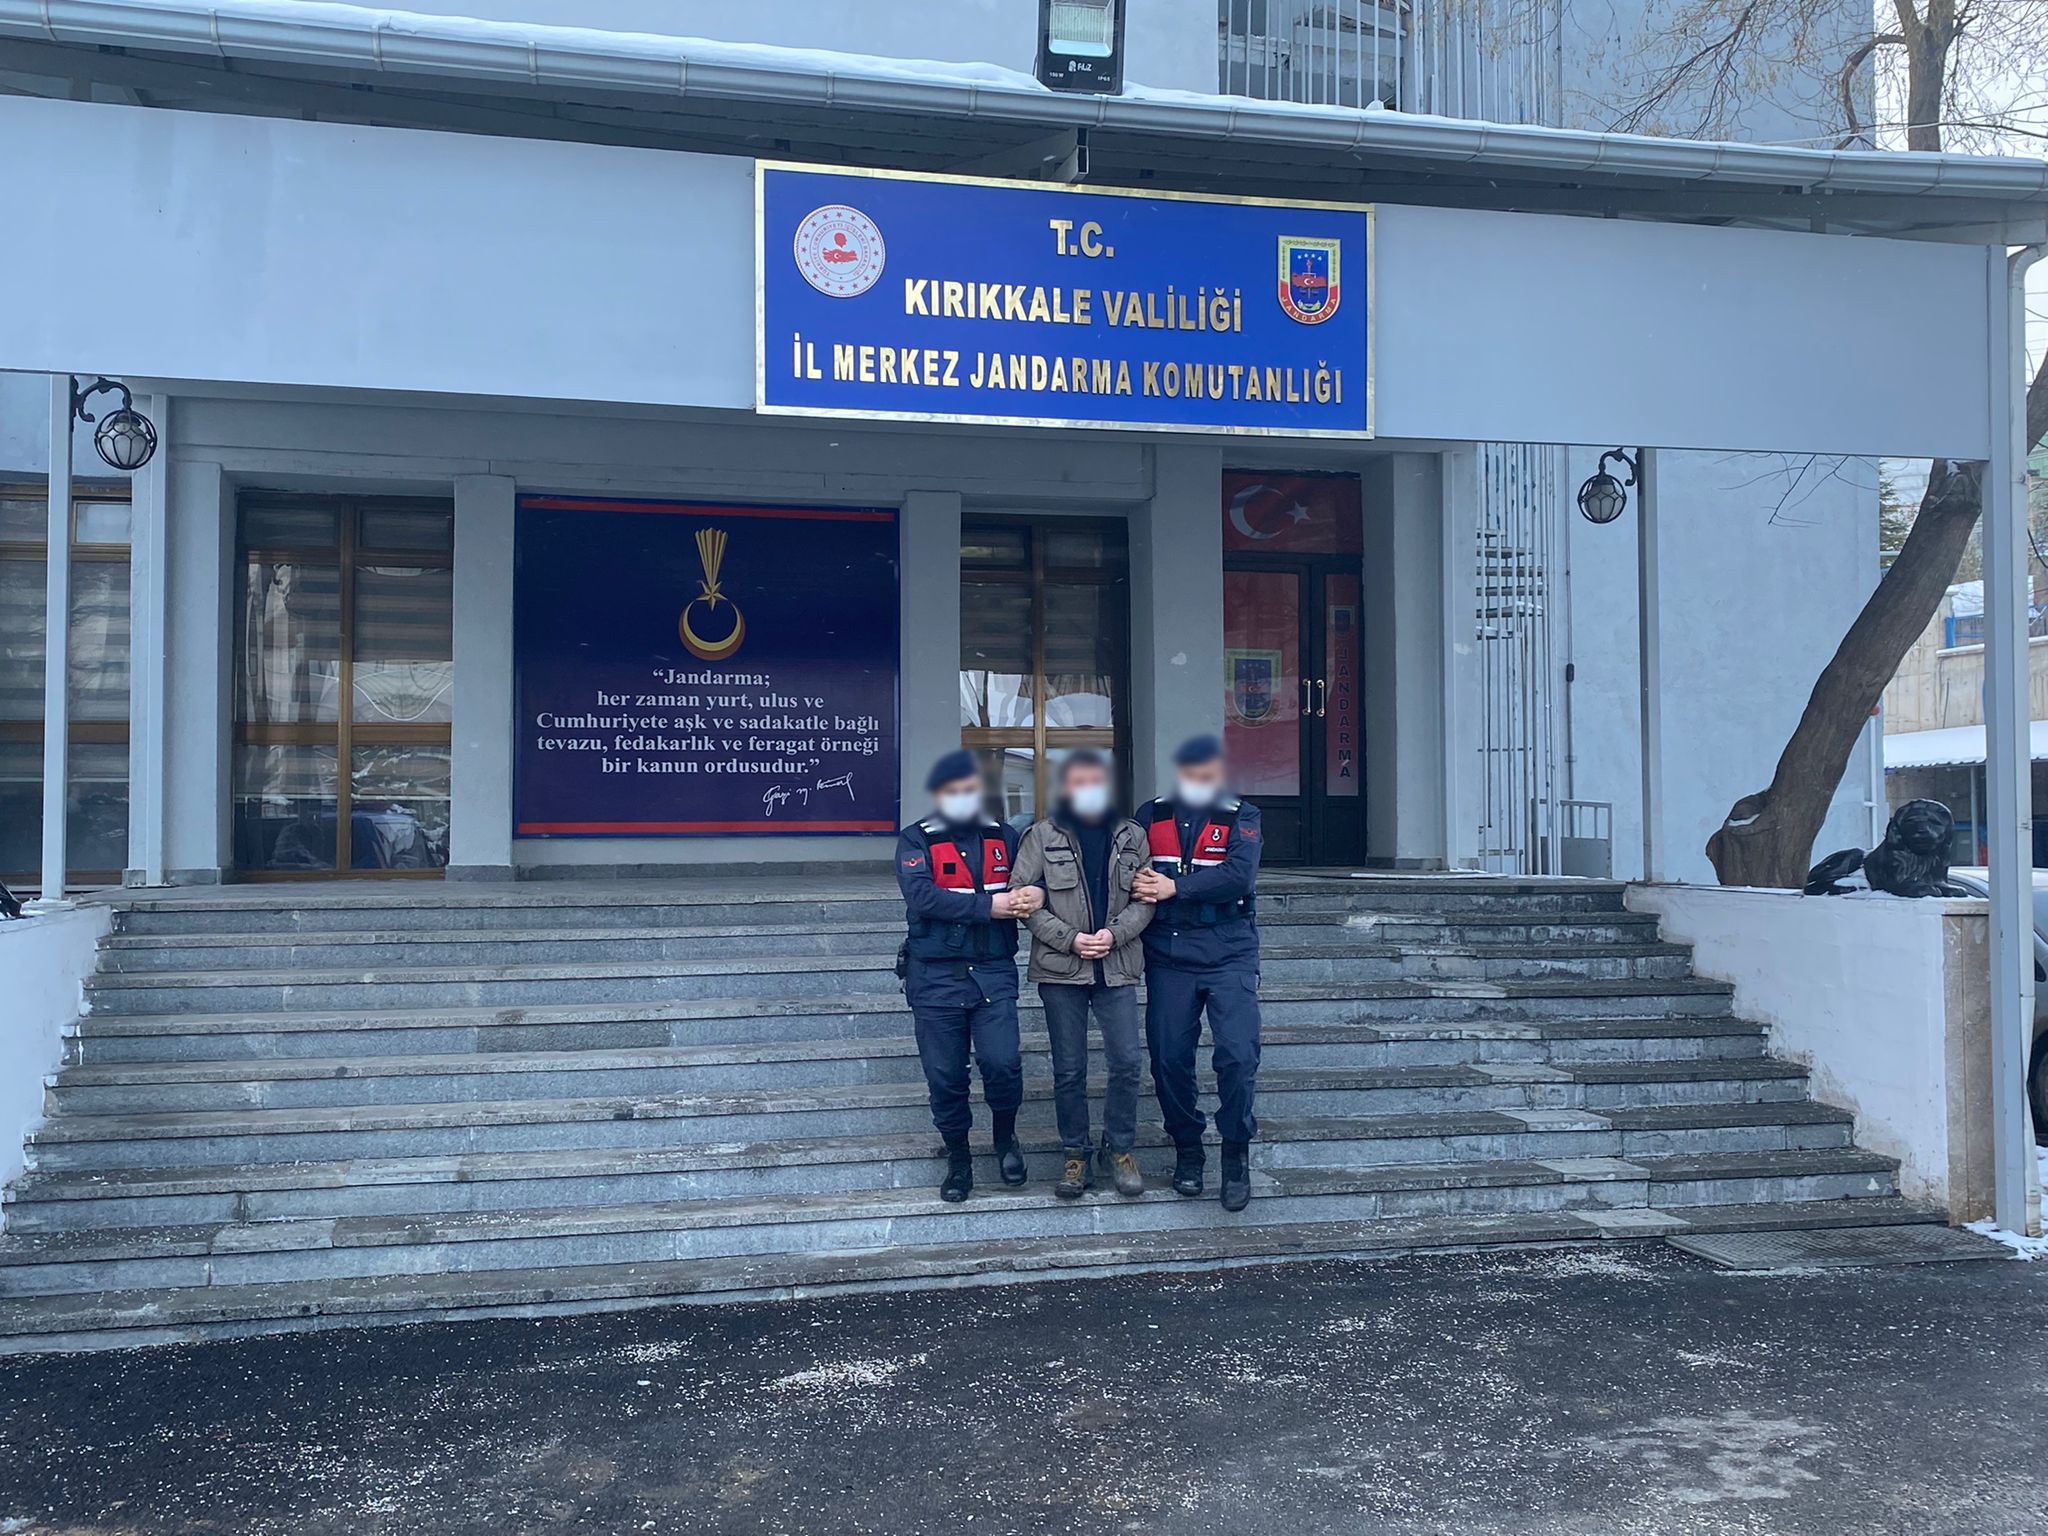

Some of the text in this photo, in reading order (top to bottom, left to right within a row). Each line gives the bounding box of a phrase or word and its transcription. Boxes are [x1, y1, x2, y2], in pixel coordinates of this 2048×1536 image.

[1050, 219, 1114, 257] T.C.
[905, 278, 1241, 332] KIRIKKALE VALİLİĞİ
[1280, 295, 1338, 321] JANDARMA
[793, 332, 1341, 404] İL MERKEZ JANDARMA KOMUTANLIĞI
[597, 691, 824, 711] her zaman yurt, ulus ve
[536, 712, 879, 735] Cumhuriyete aşk ve sadakatle bağlı
[537, 735, 879, 756] tevazu, fedakarlık ve feragat örneği
[602, 758, 631, 773] bir
[637, 758, 698, 773] kanun
